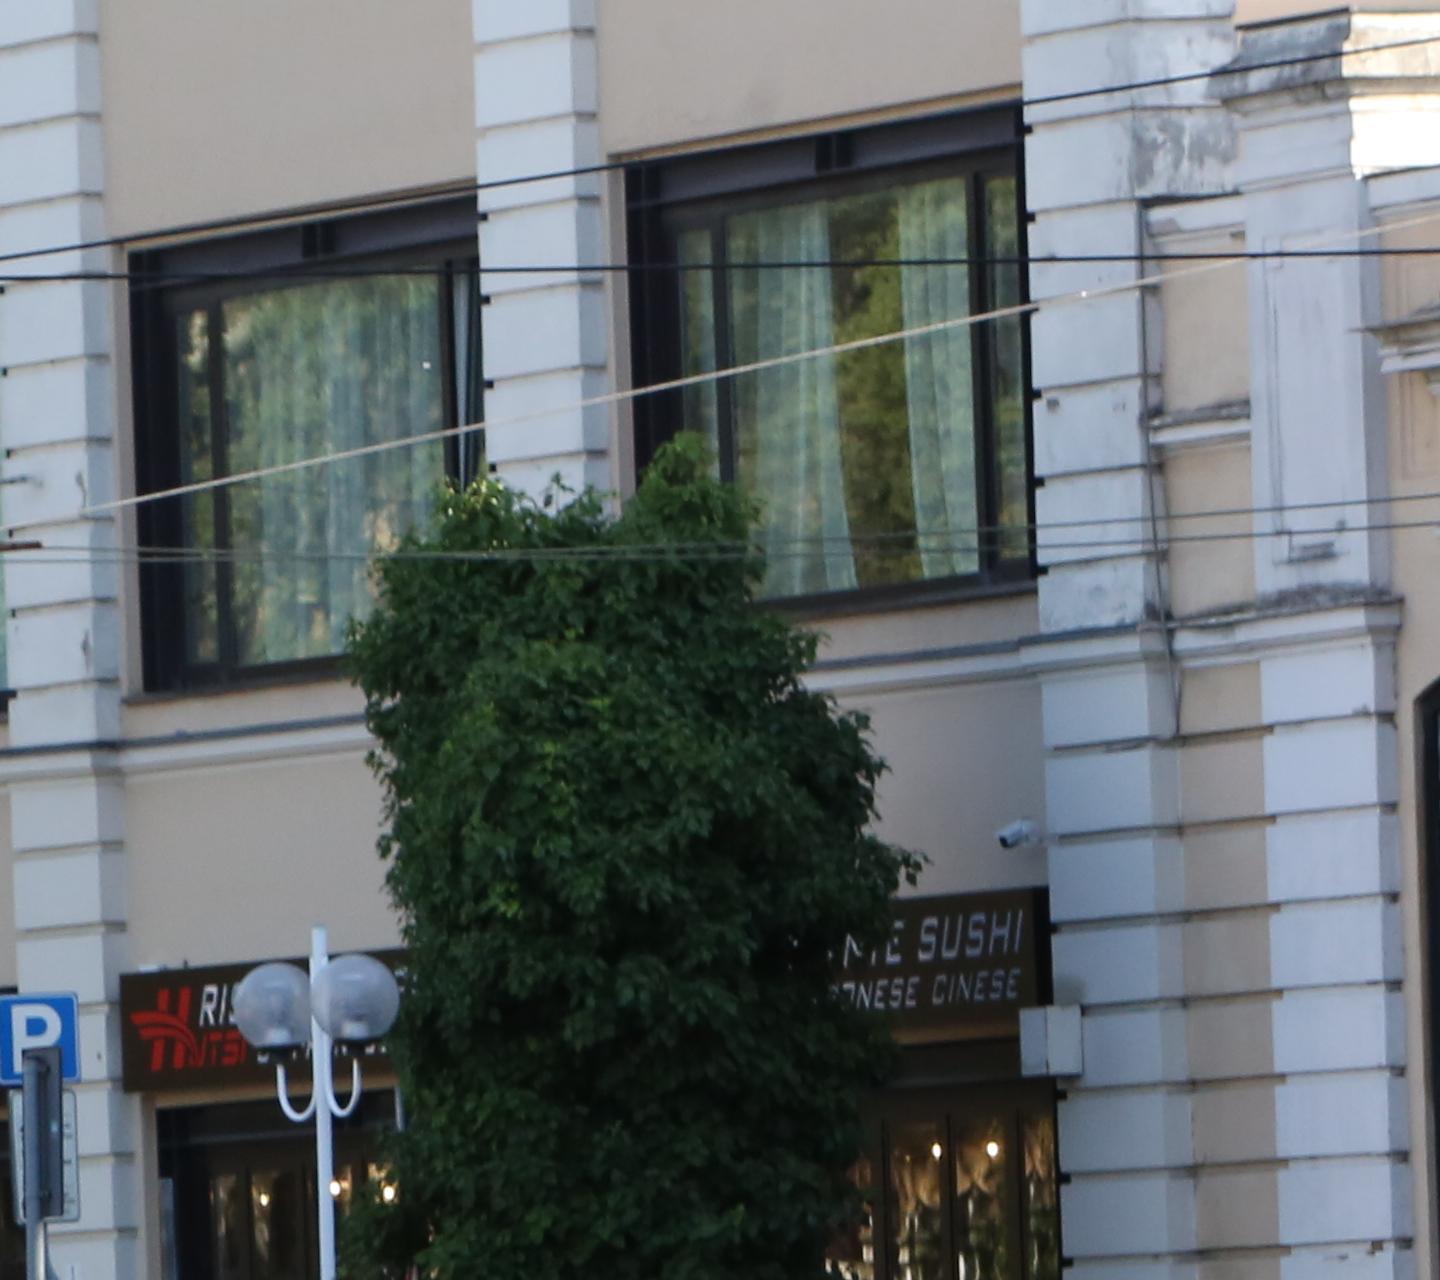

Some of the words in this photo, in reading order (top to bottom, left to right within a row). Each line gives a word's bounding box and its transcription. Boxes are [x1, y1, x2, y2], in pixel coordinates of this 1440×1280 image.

[917, 908, 1024, 963] SUSHI
[931, 967, 1022, 1006] CINESE
[10, 1003, 63, 1074] P
